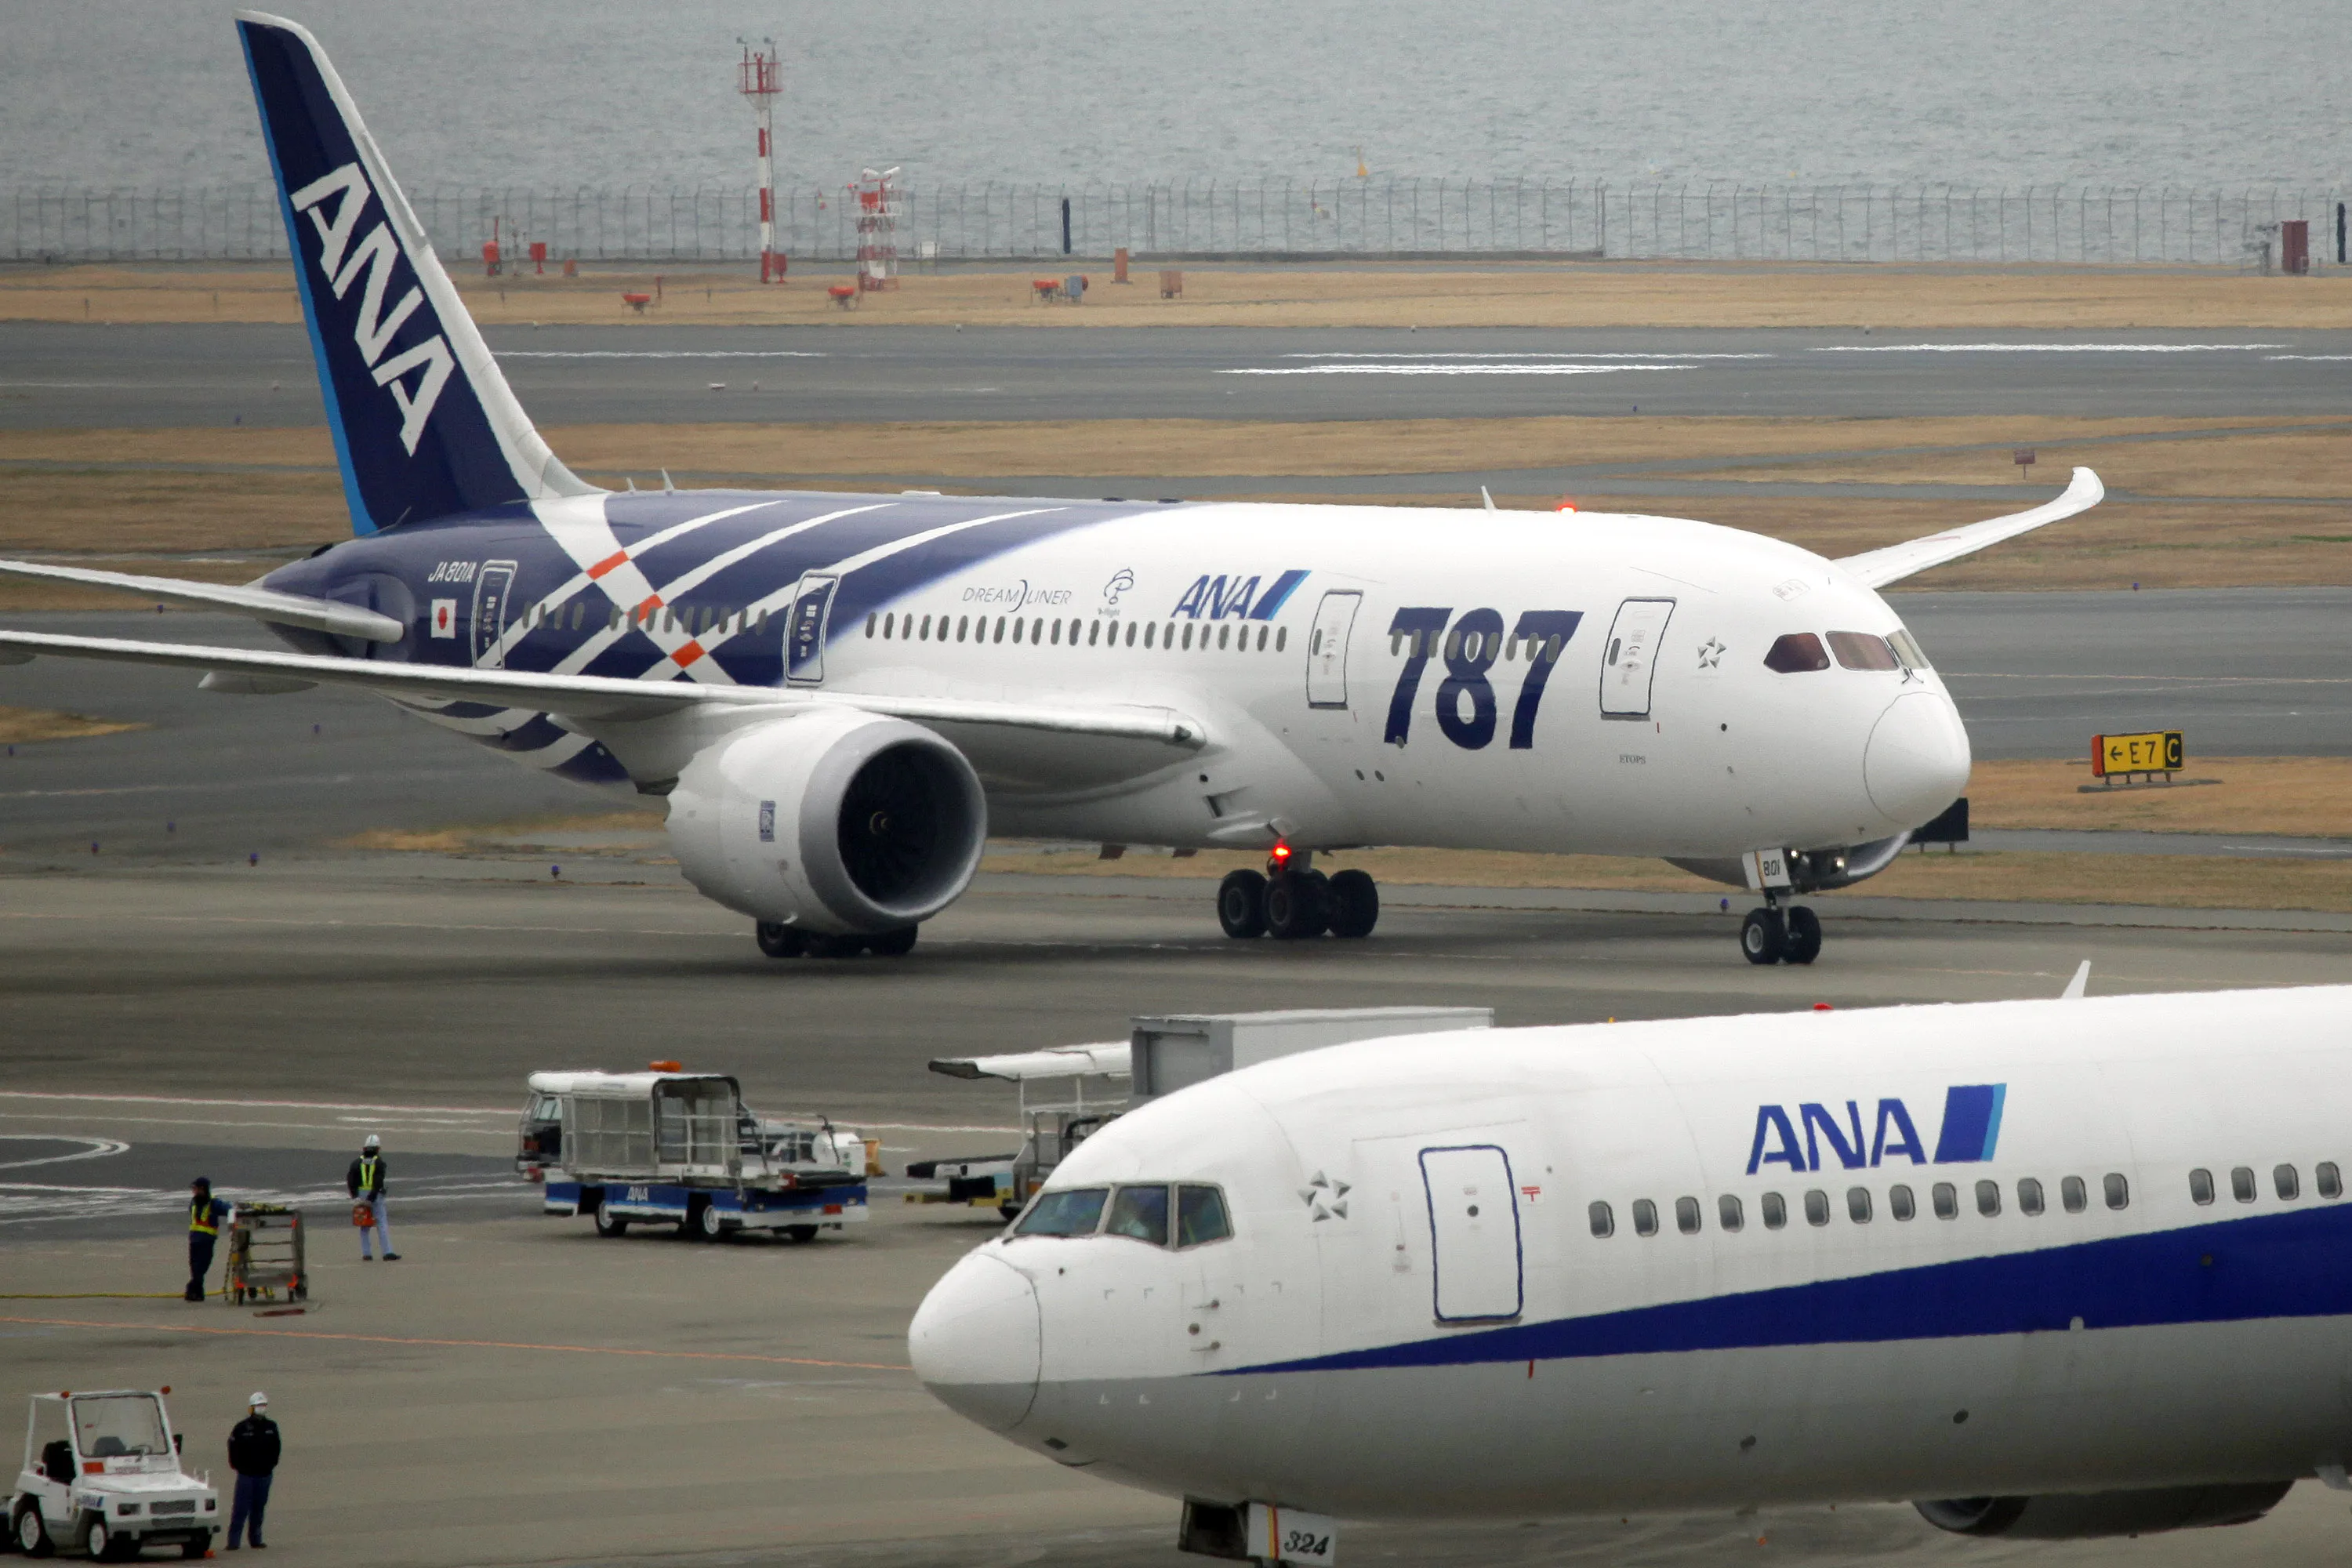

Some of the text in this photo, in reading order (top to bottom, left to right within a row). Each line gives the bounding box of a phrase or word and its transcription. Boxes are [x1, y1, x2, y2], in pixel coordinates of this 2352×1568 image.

[290, 162, 454, 457] ANA
[427, 561, 477, 582] JA801A
[1170, 575, 1261, 619] ANA
[1384, 607, 1584, 750] 787
[2167, 739, 2179, 762] C
[1763, 859, 1780, 876] 801
[1746, 1098, 1927, 1175] ANA
[626, 1186, 648, 1201] ANA
[1284, 1530, 1330, 1555] 324
